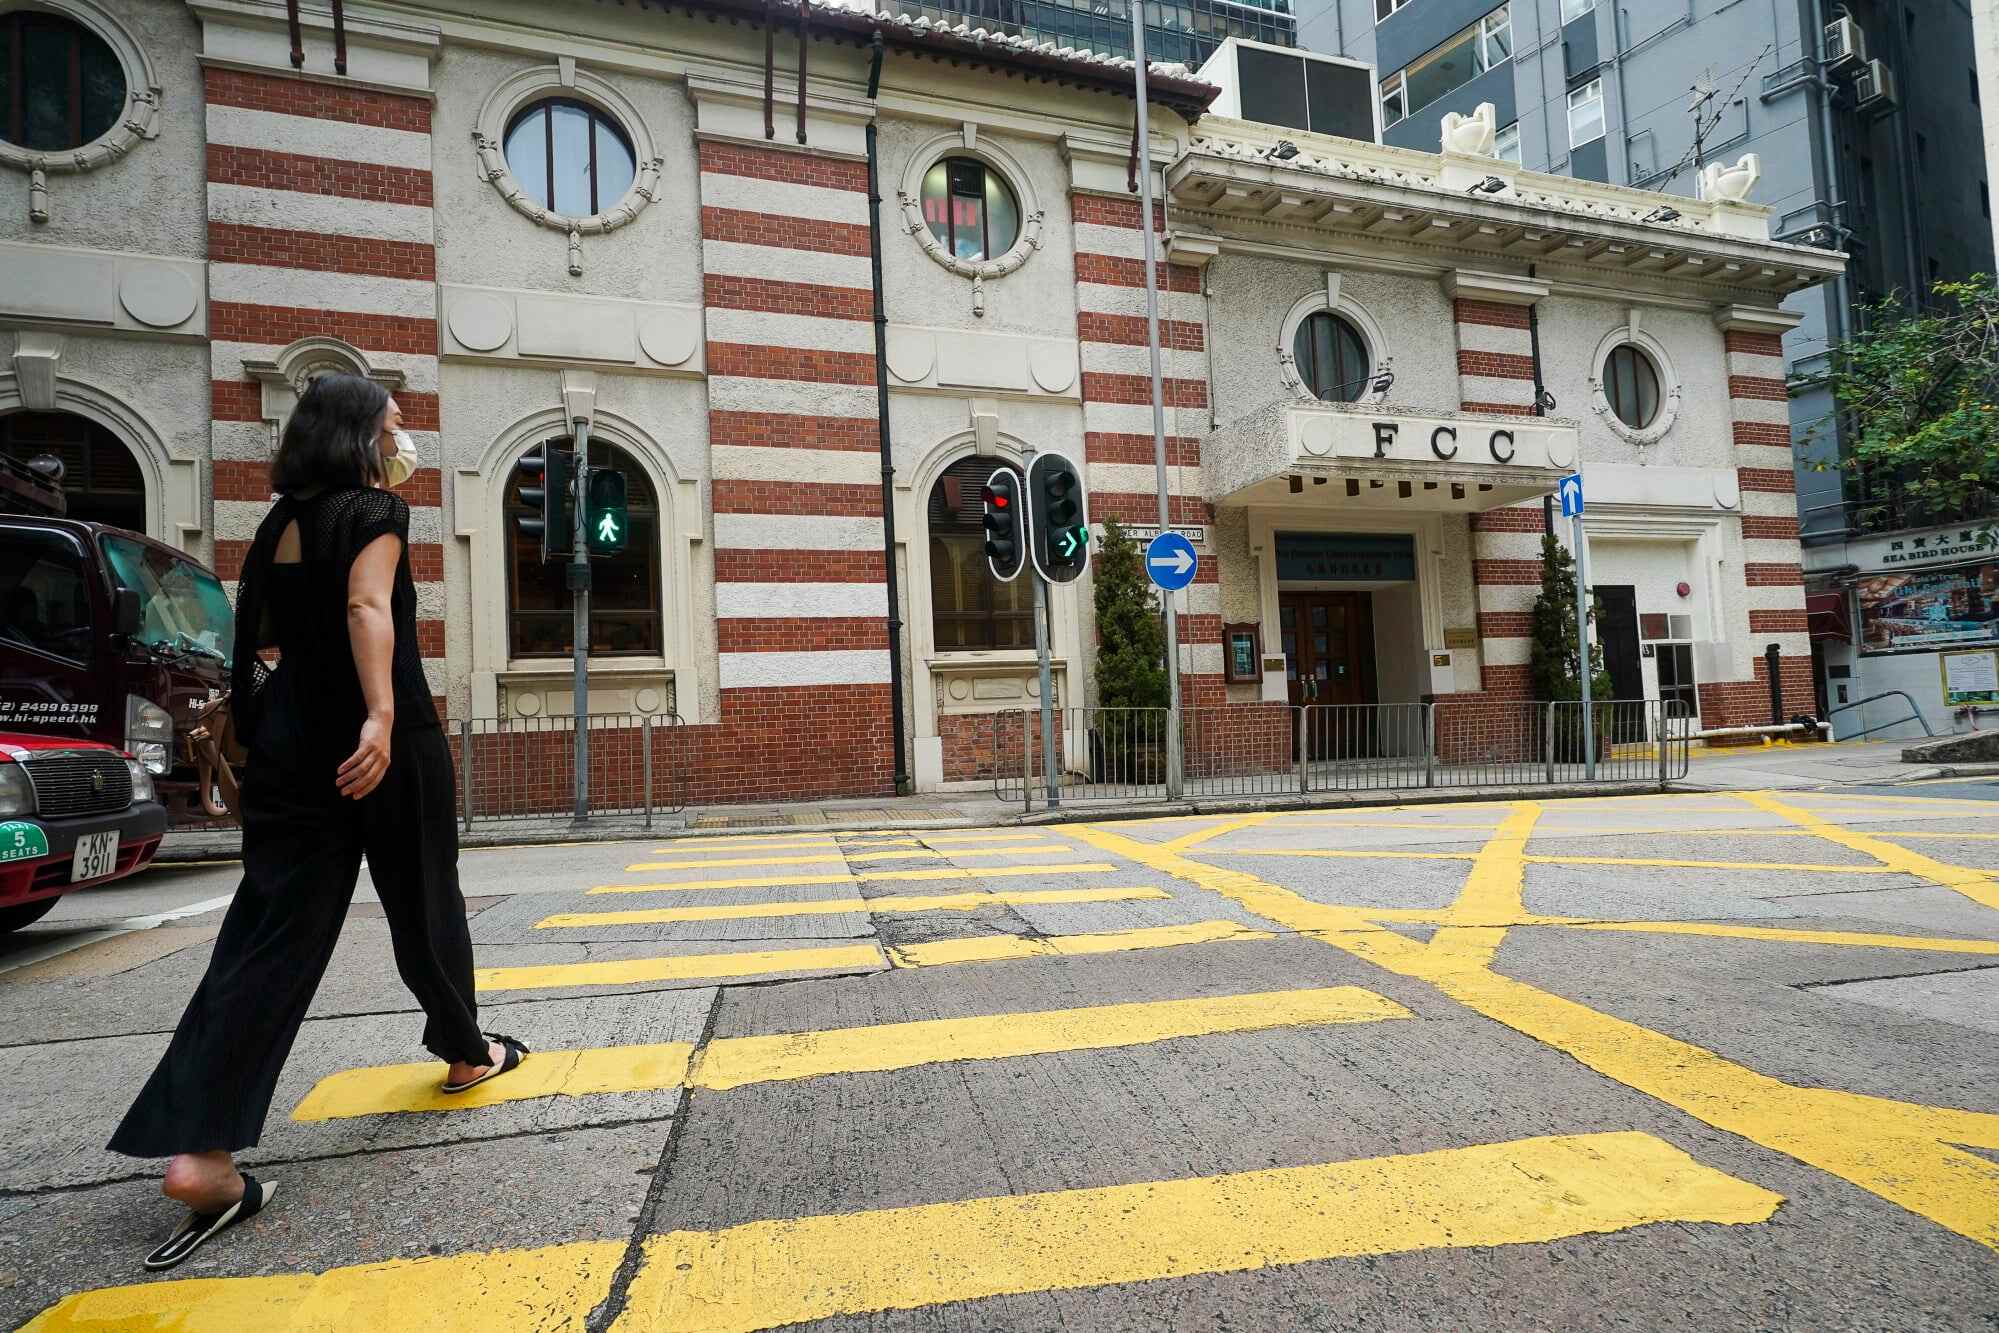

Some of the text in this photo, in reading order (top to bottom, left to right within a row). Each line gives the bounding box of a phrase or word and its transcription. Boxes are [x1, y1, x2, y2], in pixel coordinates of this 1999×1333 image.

[1882, 543, 1984, 563] SEA BIRD HOUSE
[20, 702, 99, 713] 24996399
[14, 831, 26, 847] 5
[89, 832, 109, 857] KN
[2, 846, 38, 859] SEATS
[80, 853, 111, 879] 3911
